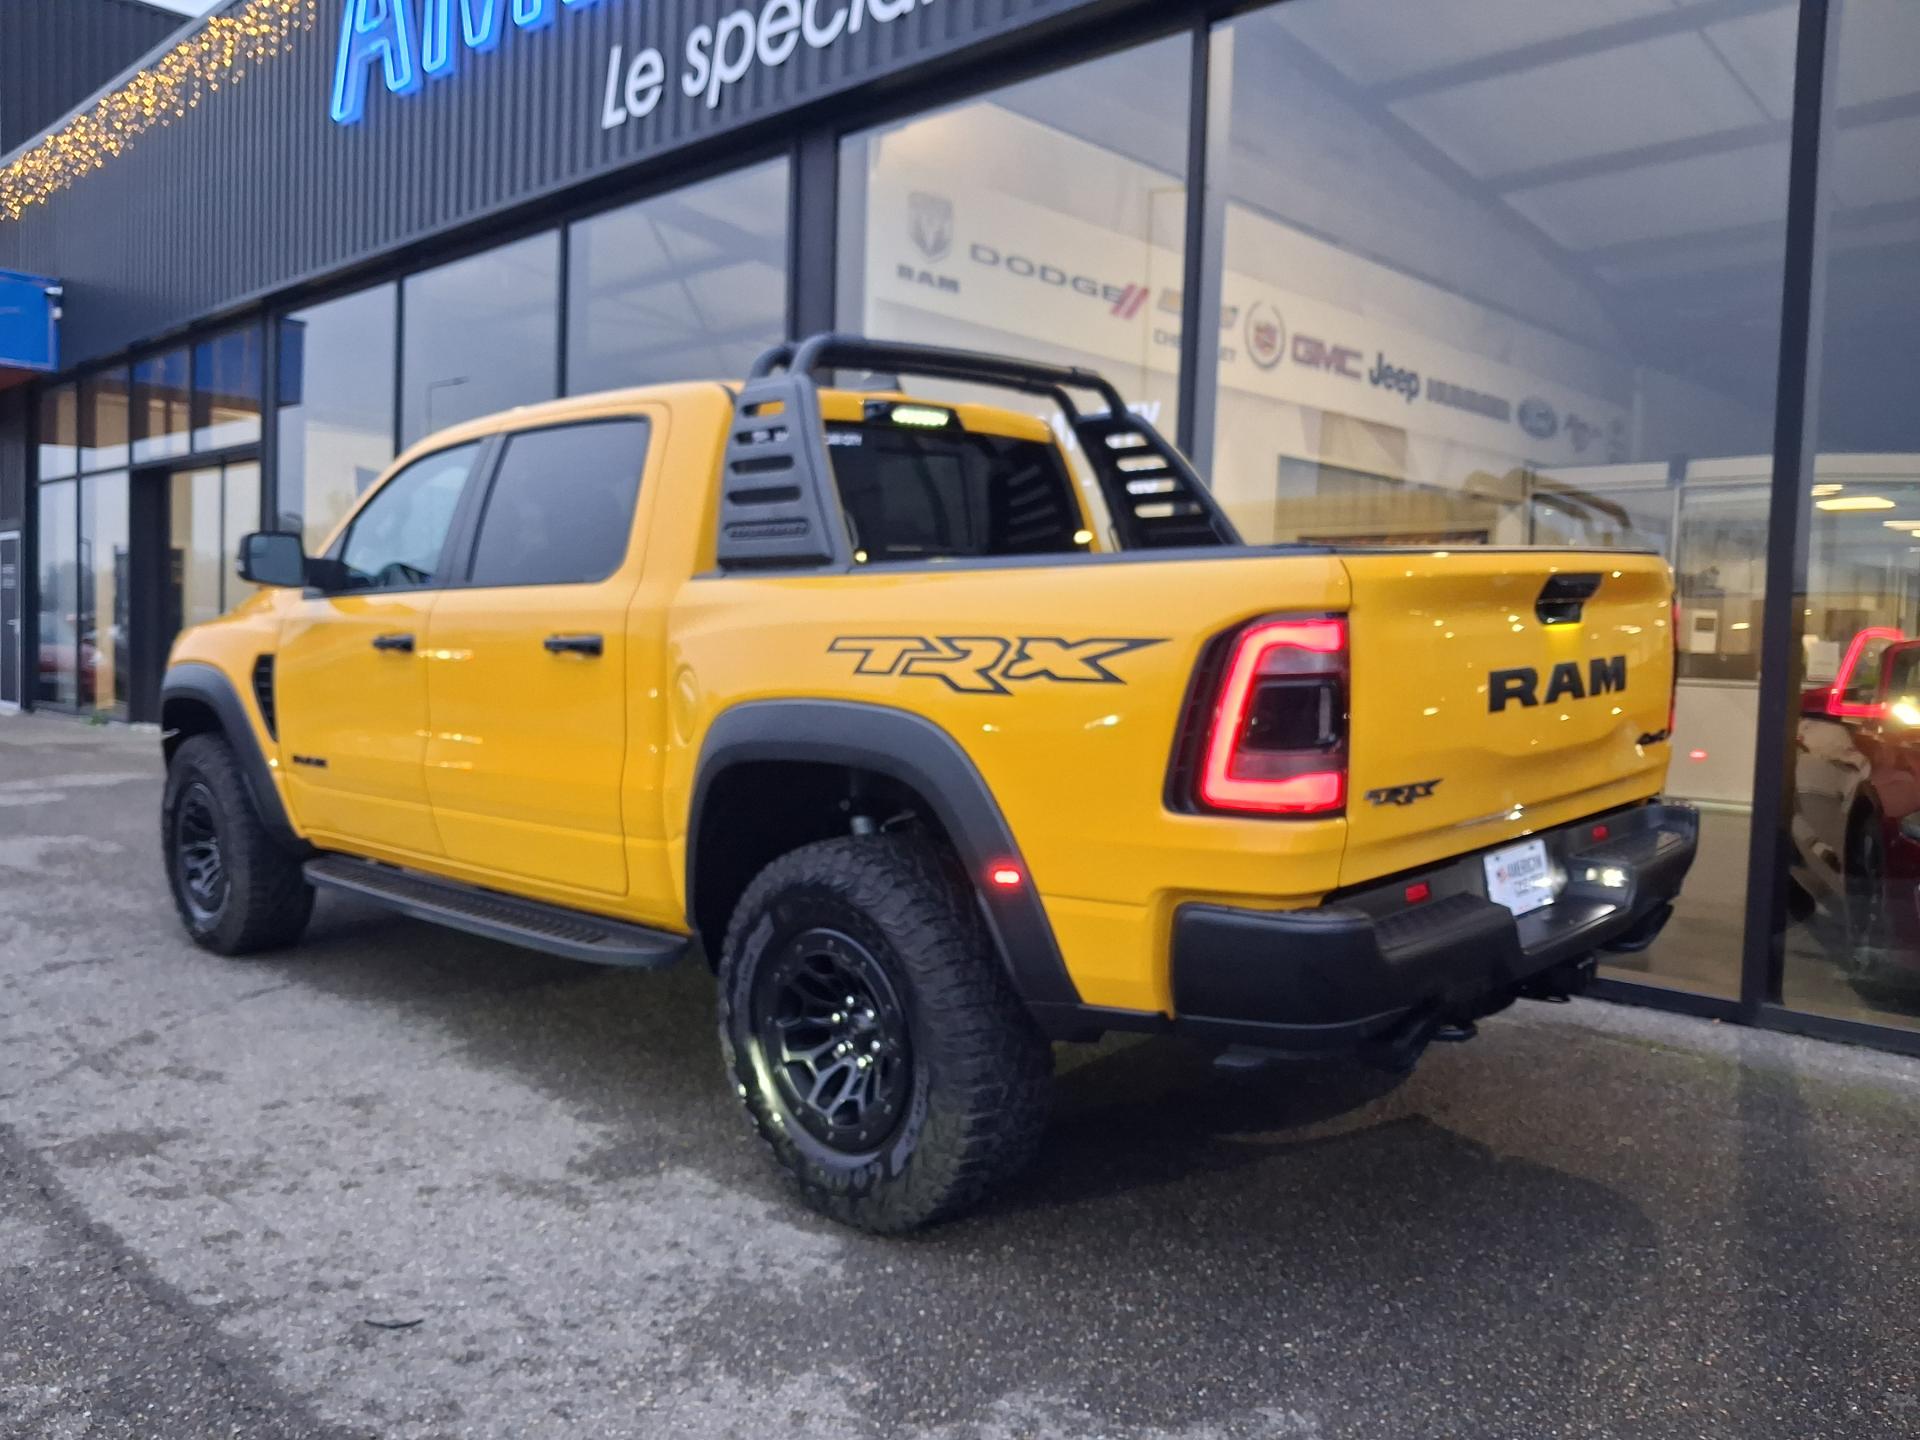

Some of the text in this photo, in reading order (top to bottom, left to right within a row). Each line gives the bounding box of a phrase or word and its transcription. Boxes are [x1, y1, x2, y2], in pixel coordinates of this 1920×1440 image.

[602, 46, 665, 129] Le
[681, 0, 936, 109] spec
[897, 262, 961, 294] RAM
[969, 242, 1125, 304] DODGE
[1292, 333, 1364, 382] GMC
[1369, 351, 1421, 405] Jeep
[827, 636, 1174, 696] TRX
[1487, 655, 1627, 714] RAM
